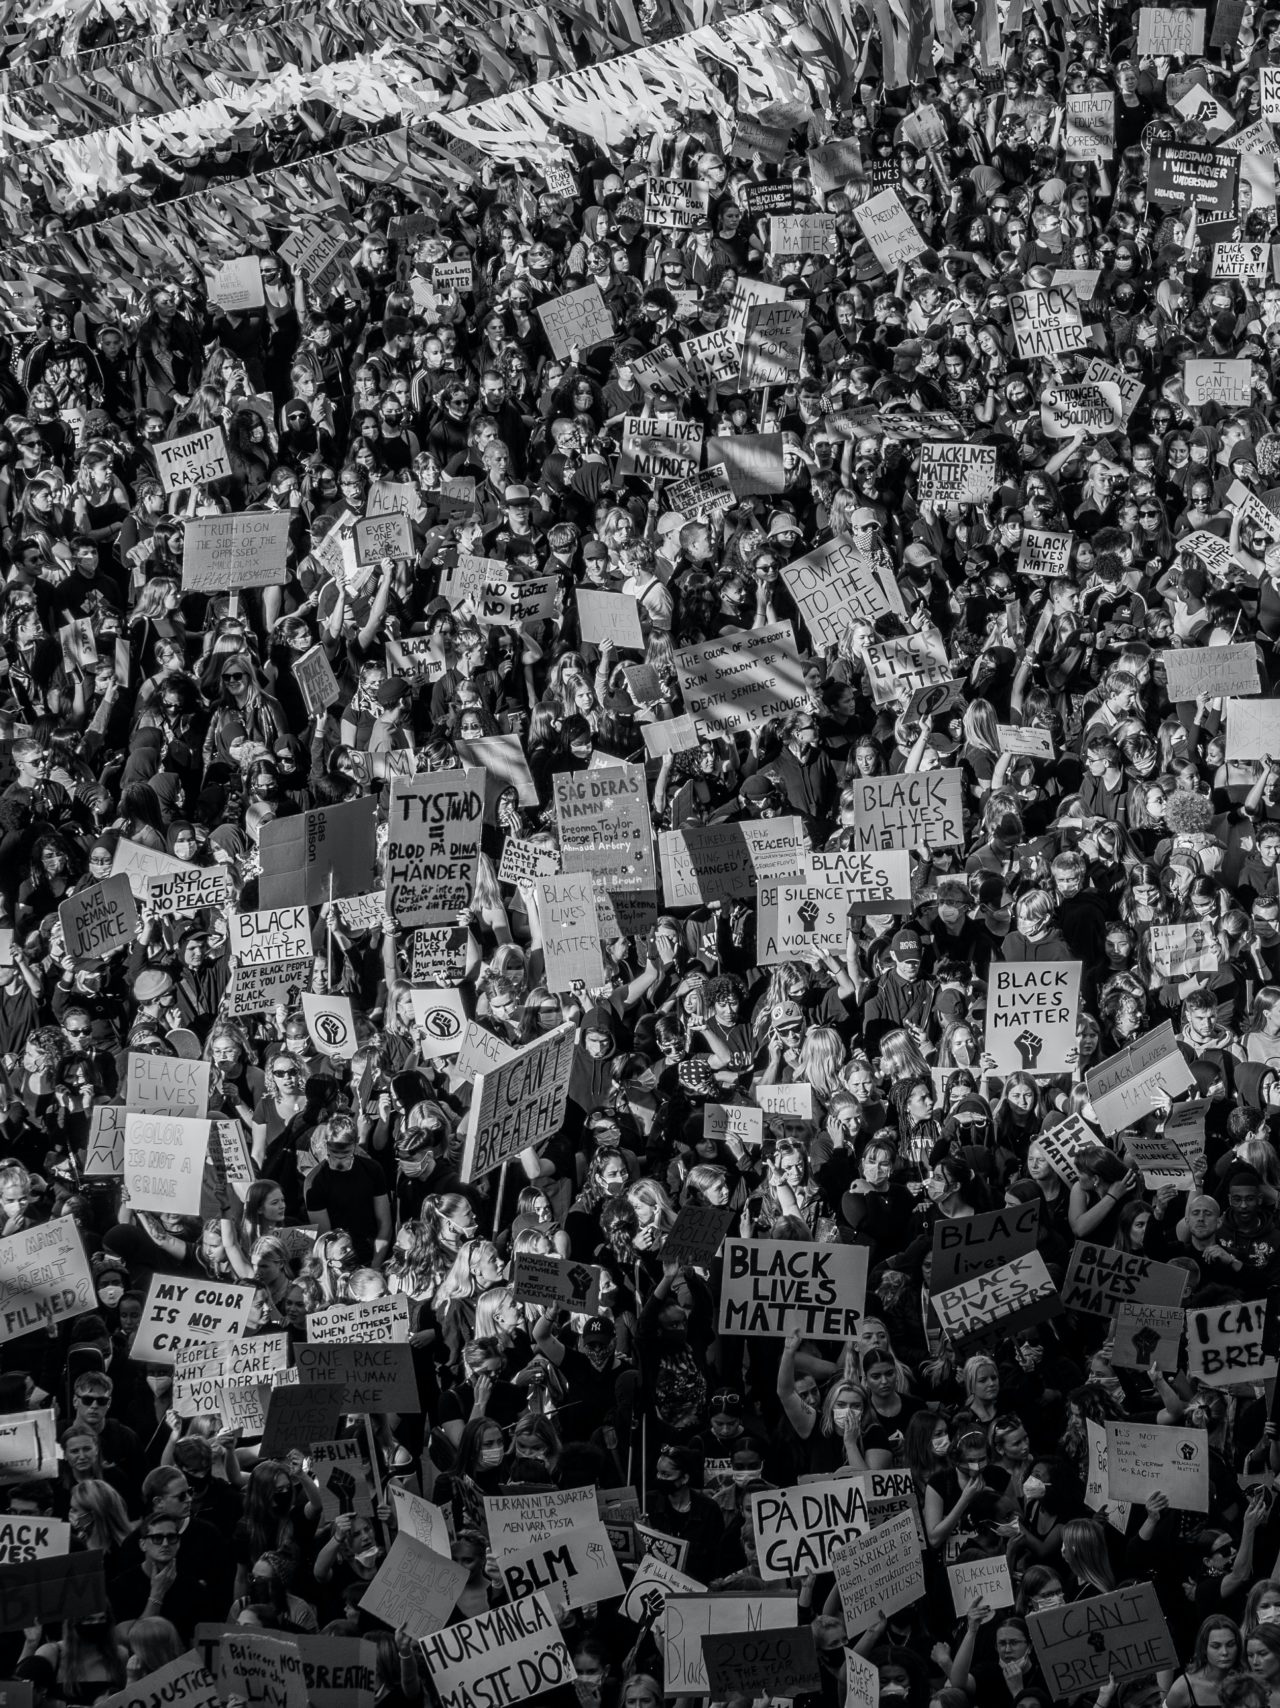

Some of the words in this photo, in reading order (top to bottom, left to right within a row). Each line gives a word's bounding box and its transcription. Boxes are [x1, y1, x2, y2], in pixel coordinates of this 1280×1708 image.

[1262, 105, 1273, 113] NO
[1158, 148, 1162, 158] I
[1165, 151, 1212, 163] UNDERSTAND
[1215, 154, 1237, 166] THAT
[1163, 162, 1167, 171] I
[1171, 162, 1196, 175] WILL
[1198, 166, 1228, 179] NEVER
[1173, 175, 1218, 188] UNDERSTAND
[650, 178, 692, 196] RACISM
[646, 212, 666, 223] ITS
[1218, 244, 1244, 255] BLACK
[1221, 254, 1245, 262] LIVES
[1012, 288, 1075, 321] BLACK
[1031, 318, 1059, 329] LIVES
[1018, 325, 1084, 356] MATTER
[1050, 386, 1100, 406] STRONGER
[1065, 399, 1107, 409] TOGETHER
[629, 418, 662, 436] BLUE
[665, 422, 701, 441] LIVES
[1054, 412, 1062, 421] IN
[1062, 408, 1114, 430] SOLIDARITY
[161, 434, 214, 462] TRUMP
[170, 458, 225, 486] RASIST
[634, 454, 697, 479] MURDER
[1027, 537, 1068, 550] BLACK
[1030, 548, 1062, 561] LIVES
[1023, 558, 1064, 572] MATTER
[486, 584, 507, 596] NO
[511, 583, 547, 598] JUSTICE
[483, 602, 504, 616] NO
[511, 602, 540, 619] PEACE
[681, 652, 699, 669] THE
[704, 645, 729, 662] COLOR
[733, 642, 743, 652] OF
[685, 671, 708, 690] SKIN
[766, 654, 778, 664] BE
[782, 652, 788, 661] A
[691, 691, 726, 713] DEATH
[731, 679, 776, 702] SENTENCE
[695, 712, 742, 737] ENOUGH
[746, 707, 757, 722] IS
[762, 695, 810, 719] ENOUGH!
[863, 778, 946, 811] BLACK
[883, 807, 944, 828] LIVES
[389, 845, 424, 860] BLOD
[430, 838, 446, 856] PÅ
[450, 843, 478, 858] DINA
[174, 871, 202, 883] NO
[391, 859, 470, 880] HÄNDER
[152, 878, 223, 898] JUSTICE
[784, 888, 843, 900] SILENCE
[153, 898, 172, 910] NO
[177, 890, 225, 909] PEACE
[240, 909, 305, 938] BLACK
[252, 932, 289, 948] LIVES
[782, 934, 842, 945] VIOLENCE
[998, 971, 1068, 989] BLACK
[998, 992, 1062, 1008] LIVES
[994, 1008, 1069, 1028] MATTER
[492, 1079, 498, 1118] I
[477, 1085, 563, 1173] BREATHE
[731, 1246, 833, 1278] BLACK
[155, 1284, 188, 1301] MY
[196, 1290, 243, 1309] COLOR
[754, 1279, 837, 1304] LIVES
[151, 1306, 177, 1322] IS
[189, 1311, 222, 1330] NOT
[228, 1320, 238, 1334] A
[726, 1300, 861, 1335] MATTER
[872, 1474, 913, 1497] BARA
[758, 1491, 797, 1535] PÅ
[803, 1488, 869, 1528] DINA
[505, 1544, 578, 1599] BLM
[421, 1624, 482, 1673] HUR
[478, 1596, 552, 1650] MÅNGA
[1036, 1619, 1048, 1647] I
[518, 1641, 571, 1694] DÖ?
[1051, 1636, 1168, 1692] BREATHE
[303, 1665, 375, 1691] BREATHE
